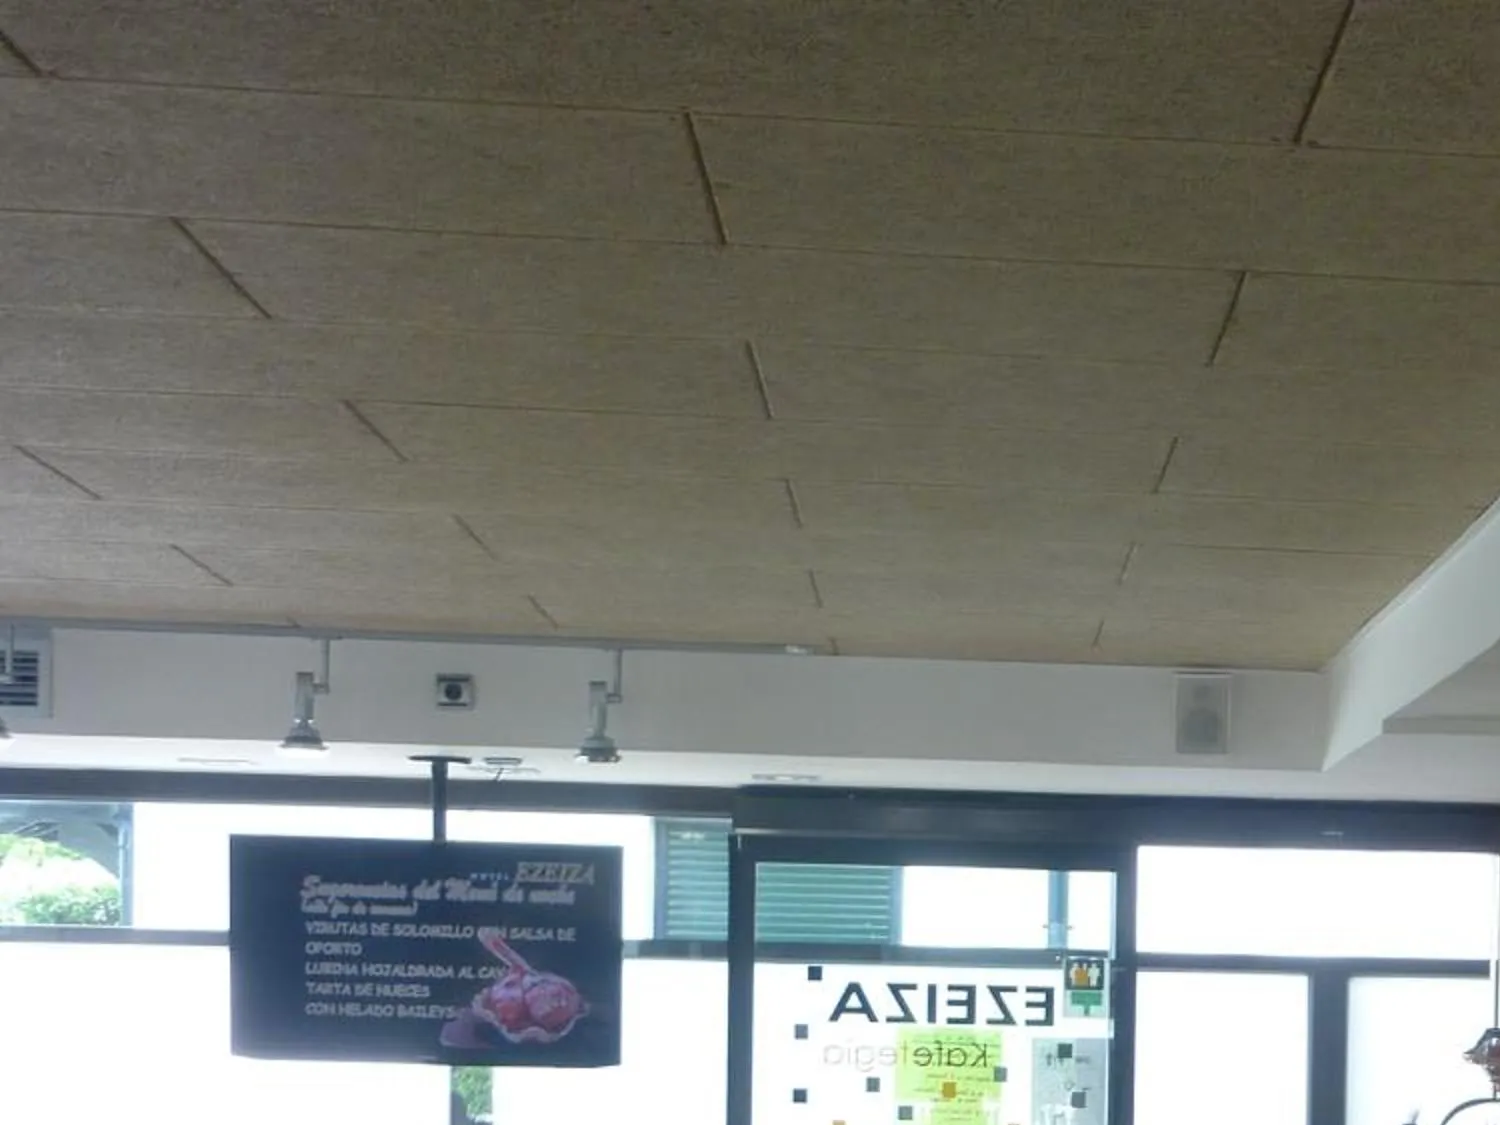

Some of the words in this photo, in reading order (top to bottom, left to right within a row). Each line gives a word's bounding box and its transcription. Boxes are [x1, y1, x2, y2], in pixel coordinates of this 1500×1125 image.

[515, 861, 595, 885] EZEIZA
[305, 921, 368, 935] VIRUTAS
[371, 922, 390, 936] DE
[393, 923, 474, 938] SOLOMILLO
[509, 927, 554, 940] SALSA
[557, 927, 577, 941] DE
[305, 942, 362, 955] OPORTO
[305, 962, 359, 976] LUBINA
[361, 963, 454, 978] HOJALDRADA
[458, 965, 476, 979] AL
[305, 982, 352, 996] TARTA
[354, 983, 374, 997] DE
[375, 983, 430, 998] NUECES
[304, 1002, 336, 1016] CON
[338, 1003, 395, 1017] HELADO
[397, 1004, 455, 1019] BAILEYS
